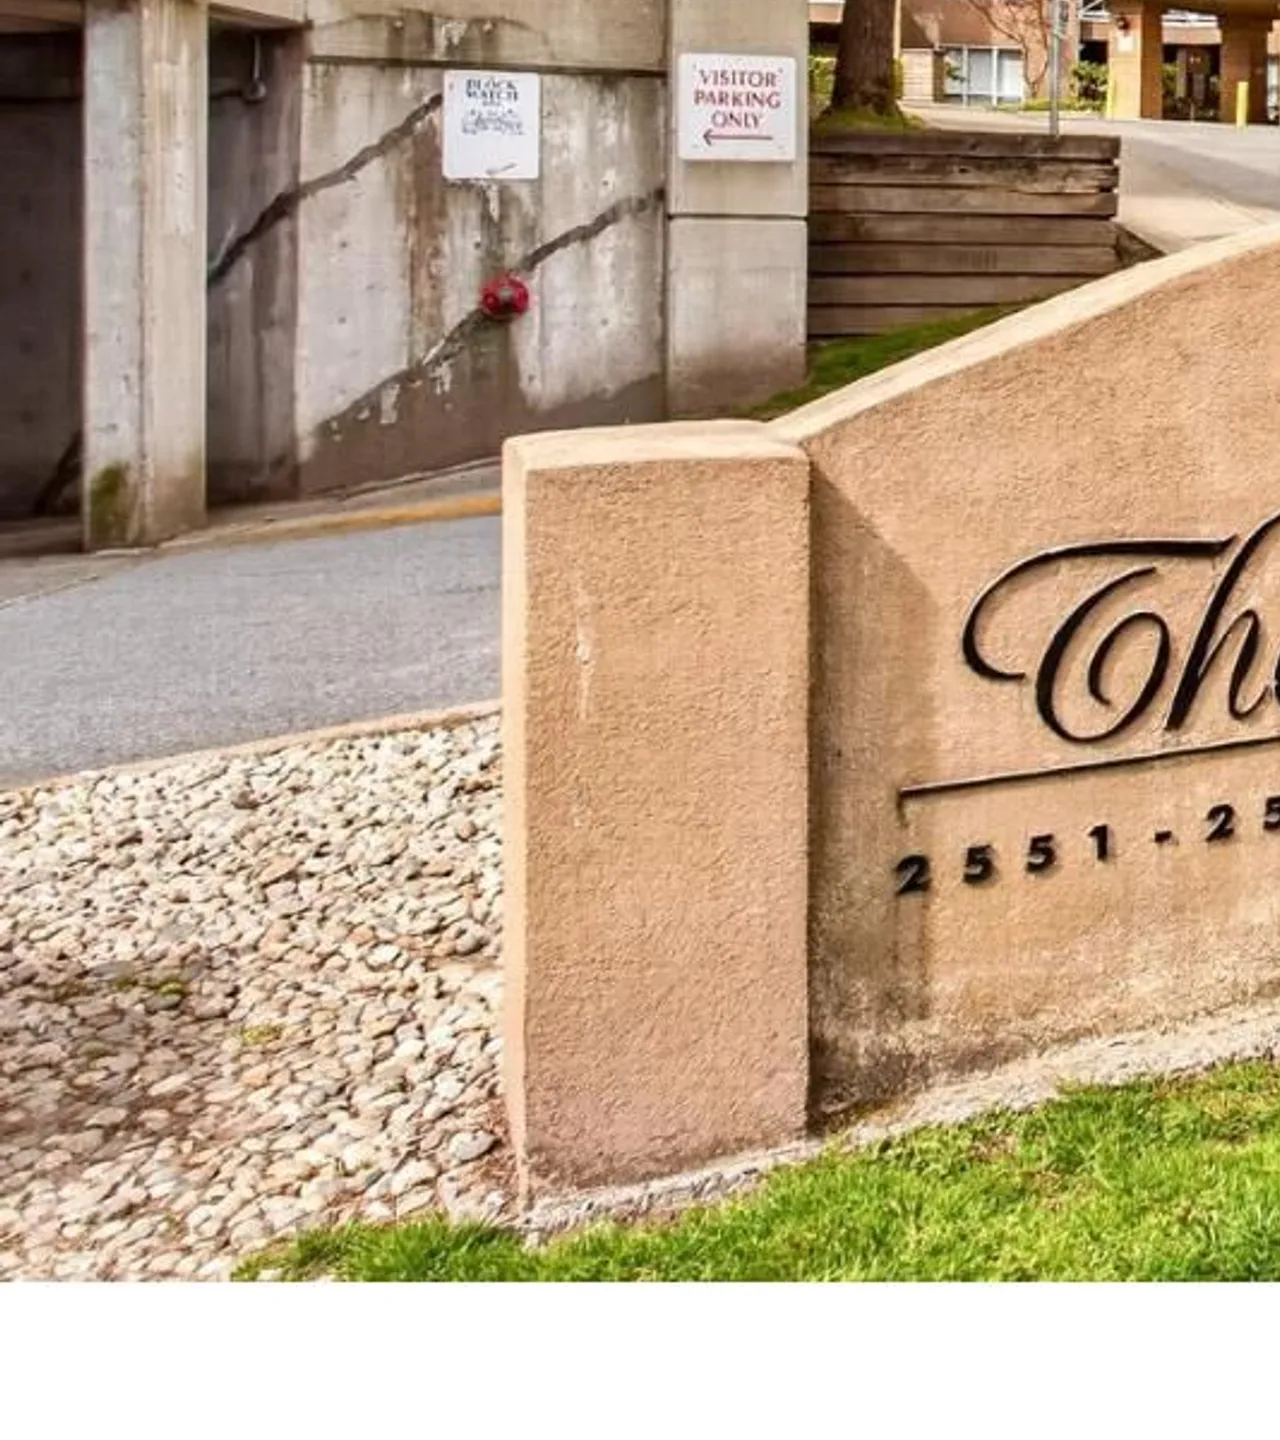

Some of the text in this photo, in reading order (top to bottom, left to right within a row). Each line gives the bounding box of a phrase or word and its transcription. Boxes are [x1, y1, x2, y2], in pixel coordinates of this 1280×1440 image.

[699, 69, 777, 87] VISITOR
[693, 89, 781, 109] PARKING
[711, 110, 763, 128] ONLY
